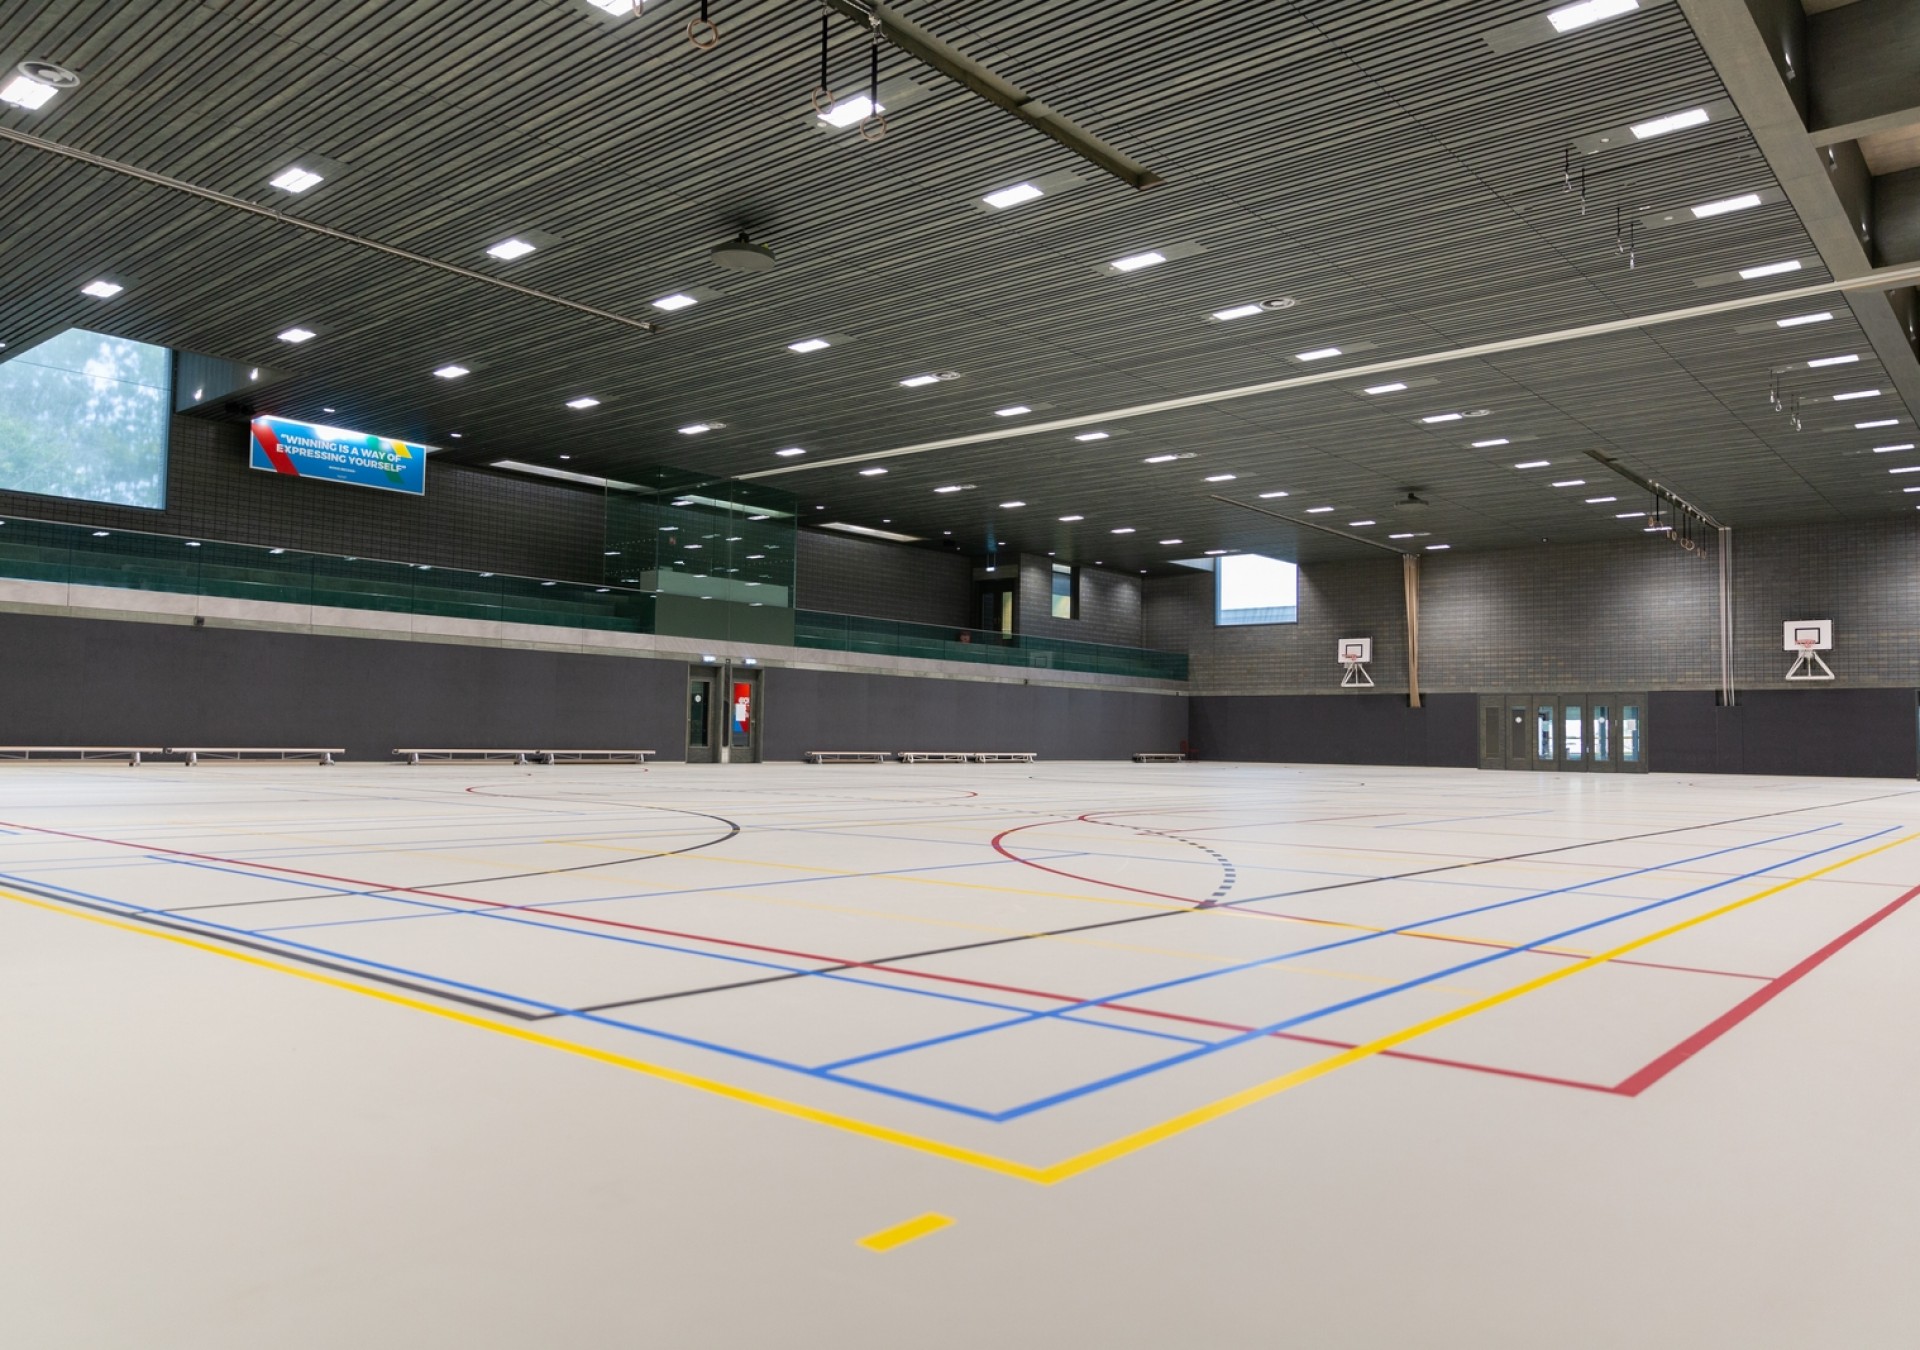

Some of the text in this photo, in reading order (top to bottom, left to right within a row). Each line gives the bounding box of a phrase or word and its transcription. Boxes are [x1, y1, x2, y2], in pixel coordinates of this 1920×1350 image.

[276, 443, 347, 464] EXPRESSING
[339, 444, 348, 454] IS
[349, 447, 359, 456] A
[361, 448, 386, 460] WAY
[387, 453, 401, 463] OF
